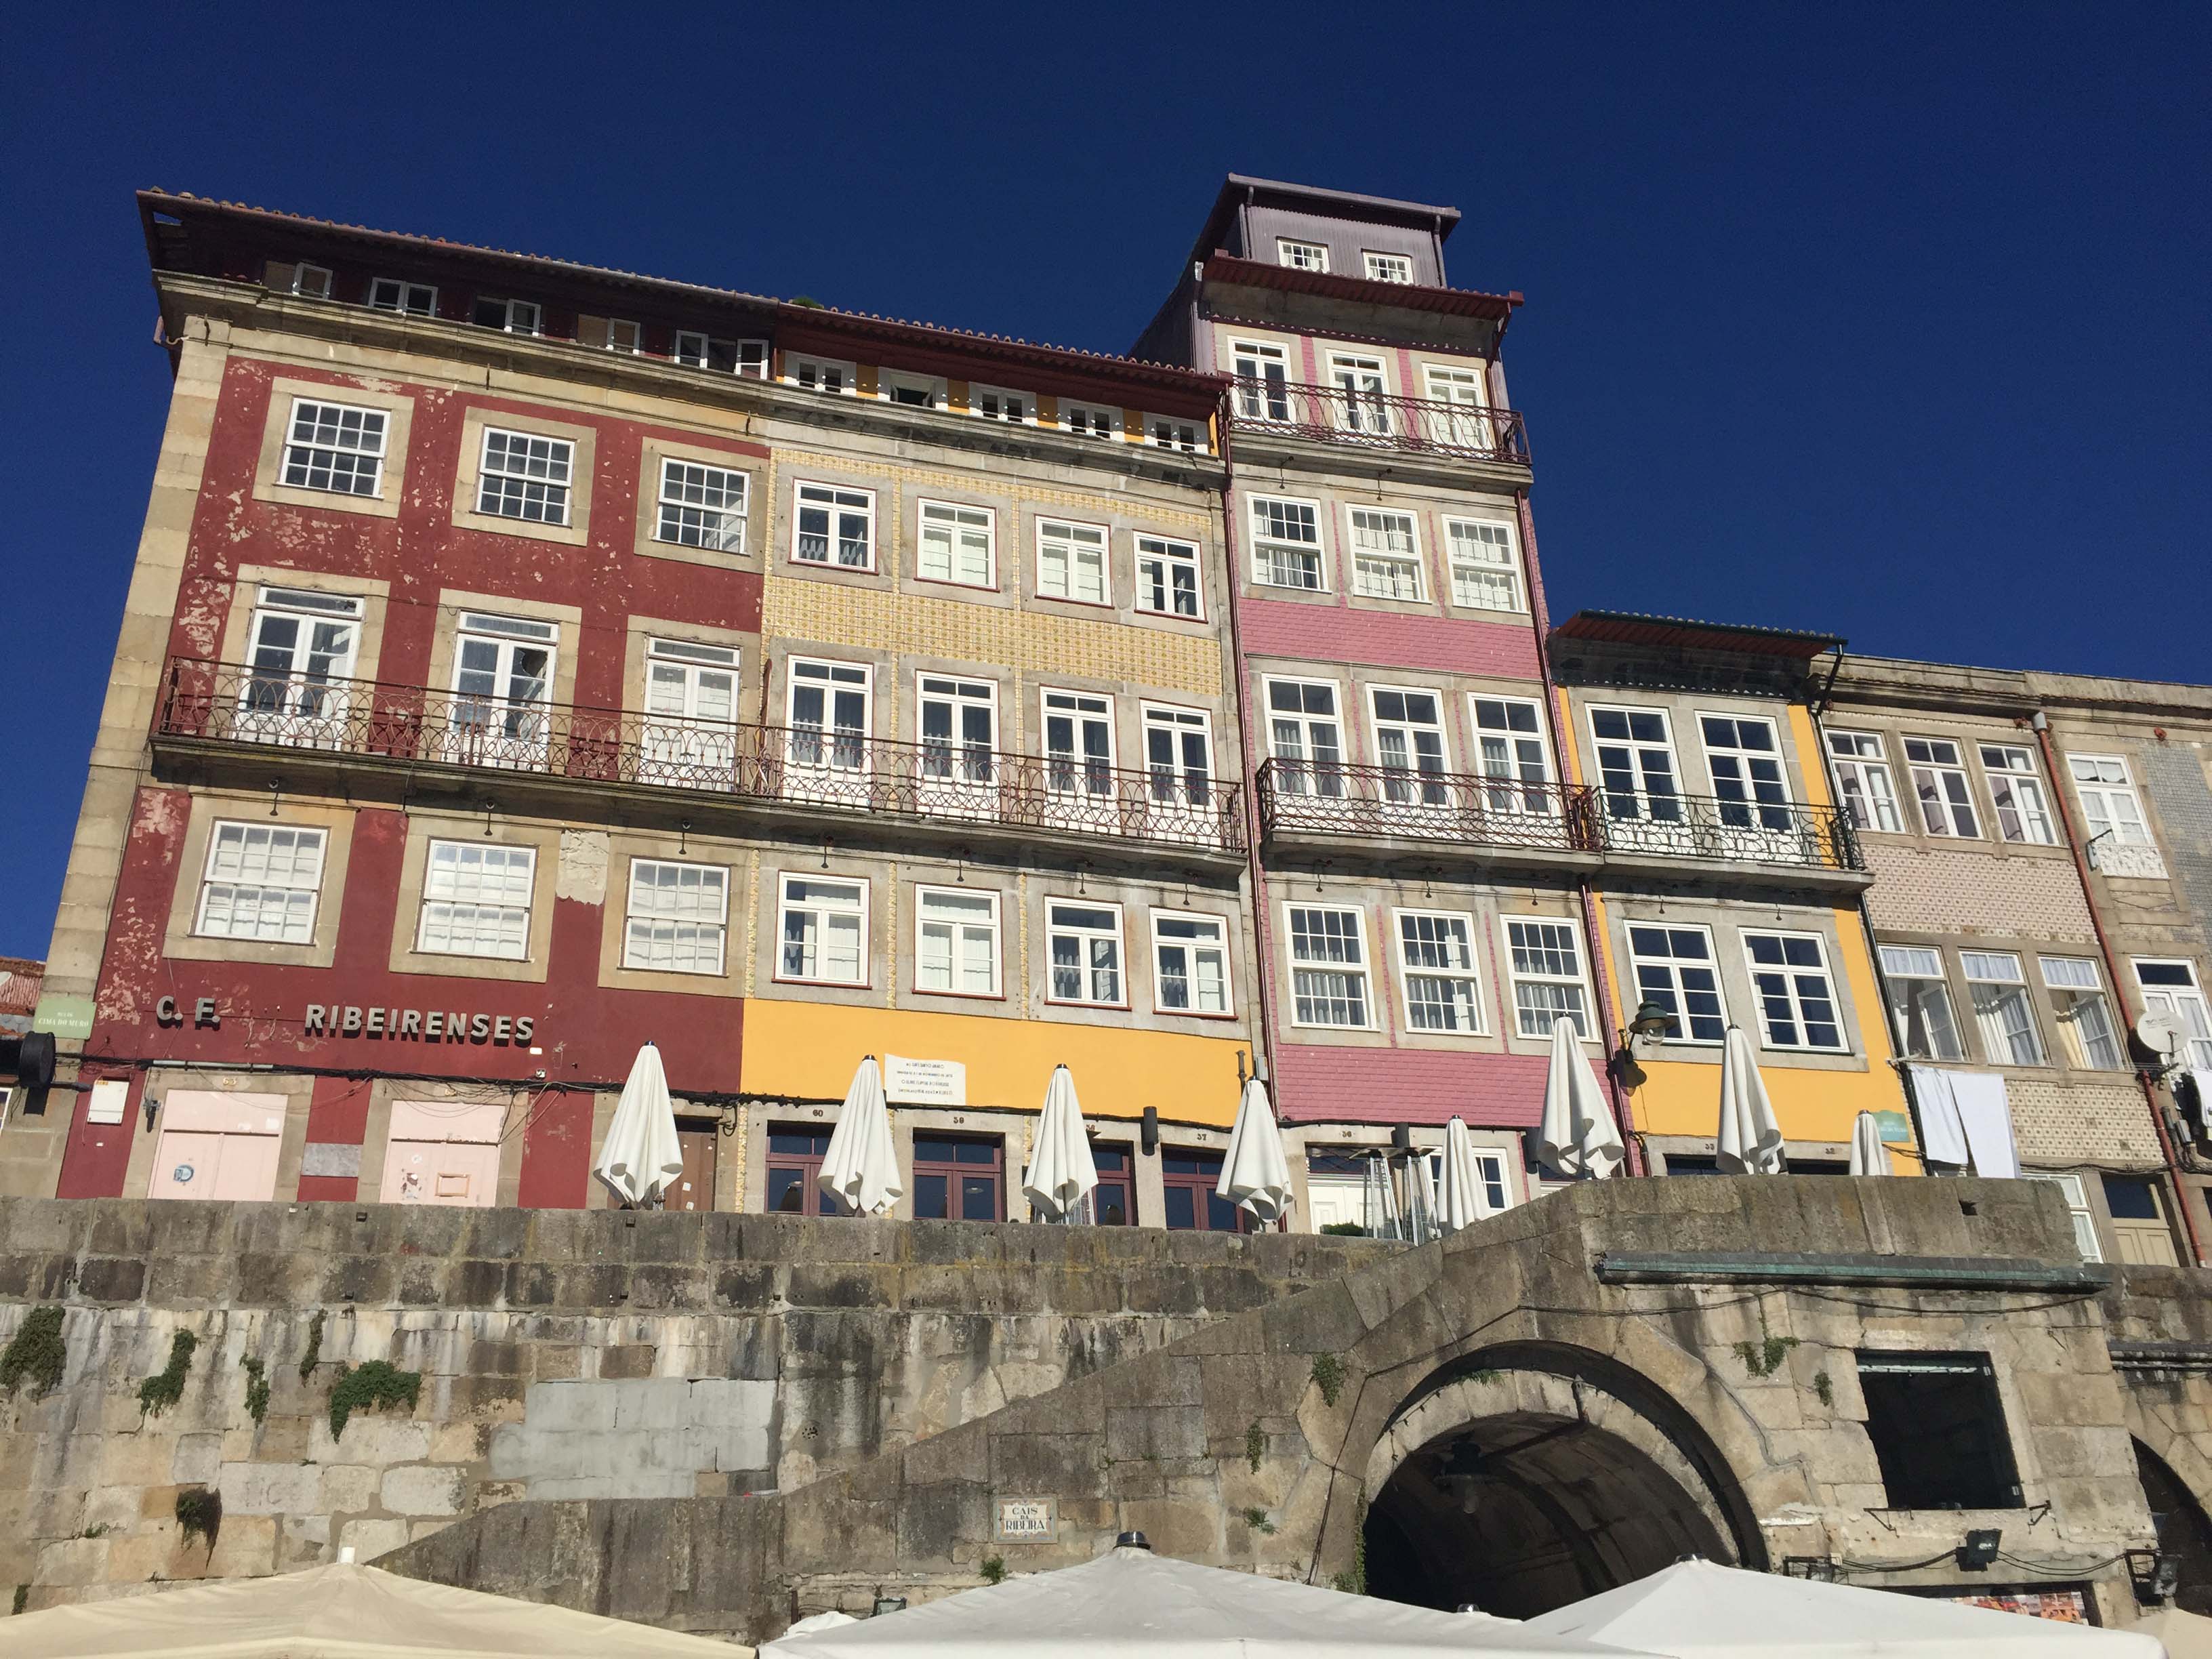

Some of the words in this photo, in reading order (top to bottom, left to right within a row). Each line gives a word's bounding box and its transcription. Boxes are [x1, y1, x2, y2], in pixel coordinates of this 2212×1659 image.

[69, 1019, 89, 1027] MURO
[305, 1004, 534, 1040] RIBEIRENSES
[1012, 1507, 1038, 1515] CAIS
[1006, 1519, 1045, 1531] RIBEIRA
